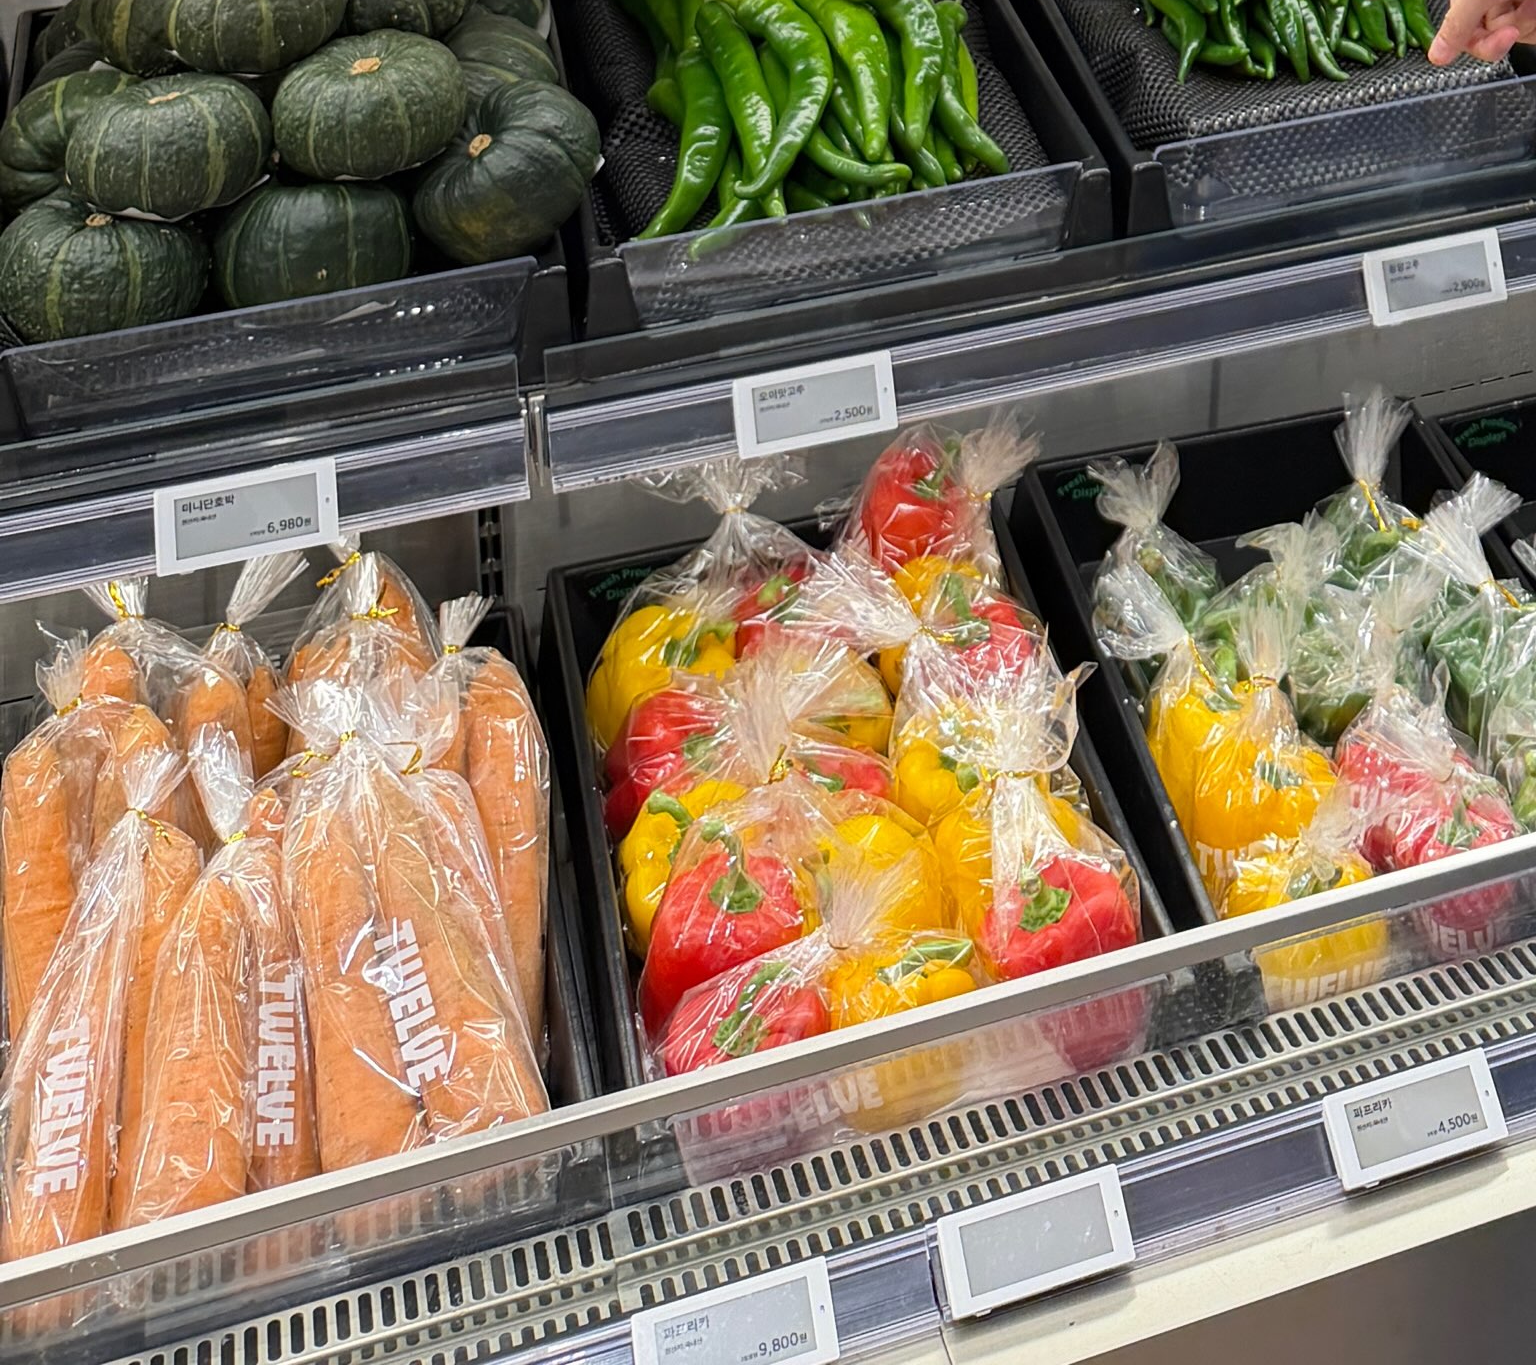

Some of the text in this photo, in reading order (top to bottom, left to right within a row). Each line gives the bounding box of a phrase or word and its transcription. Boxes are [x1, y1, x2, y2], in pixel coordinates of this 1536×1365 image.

[182, 494, 235, 513] 미니단호박
[256, 973, 297, 1147] TWELVE
[374, 919, 450, 1087] TWELVE
[32, 1016, 93, 1197] TWELVE
[1353, 1097, 1392, 1118] 파프리카
